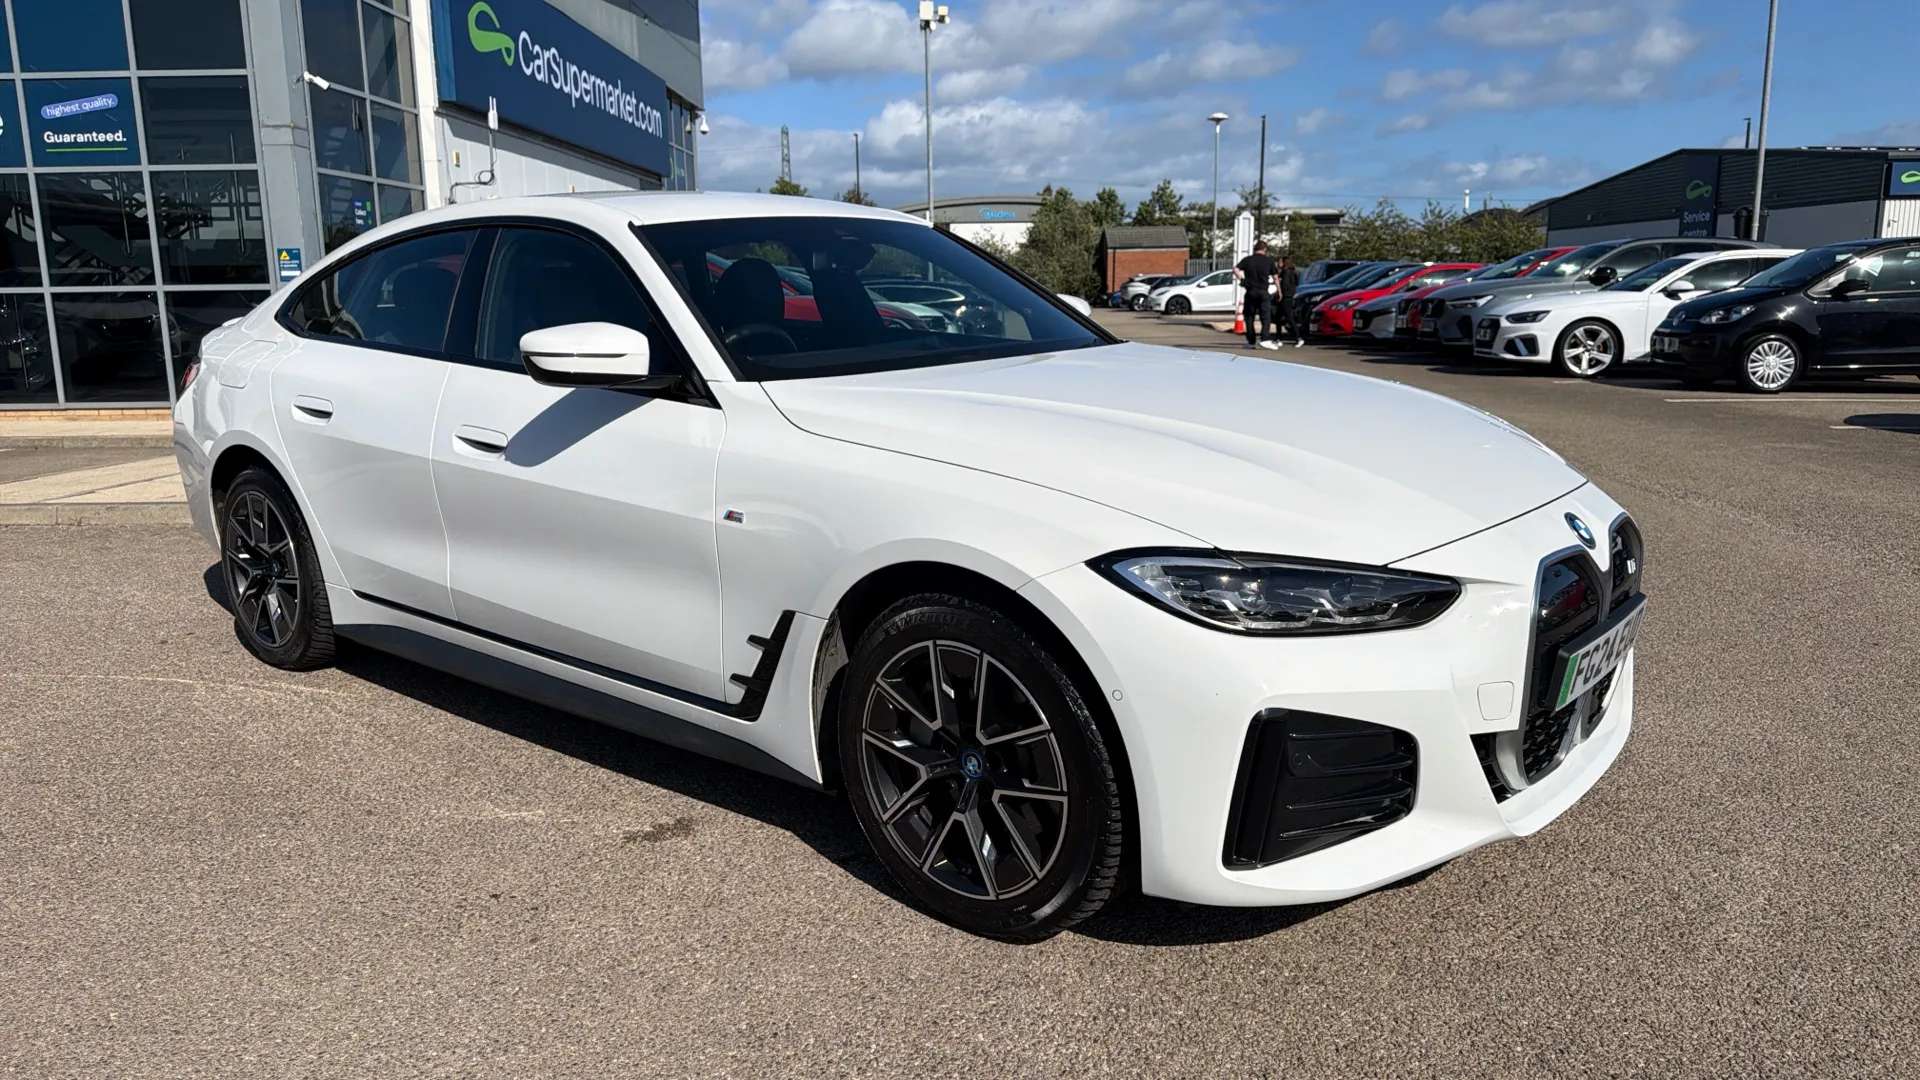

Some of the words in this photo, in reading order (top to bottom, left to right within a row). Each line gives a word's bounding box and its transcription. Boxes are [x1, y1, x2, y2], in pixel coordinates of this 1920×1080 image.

[518, 30, 662, 138] CarSupermarket.com
[46, 103, 81, 117] highest
[82, 97, 115, 111] quality.
[43, 129, 127, 143] Guaranteed.
[1683, 210, 1710, 223] Service
[1570, 628, 1619, 695] FG24
